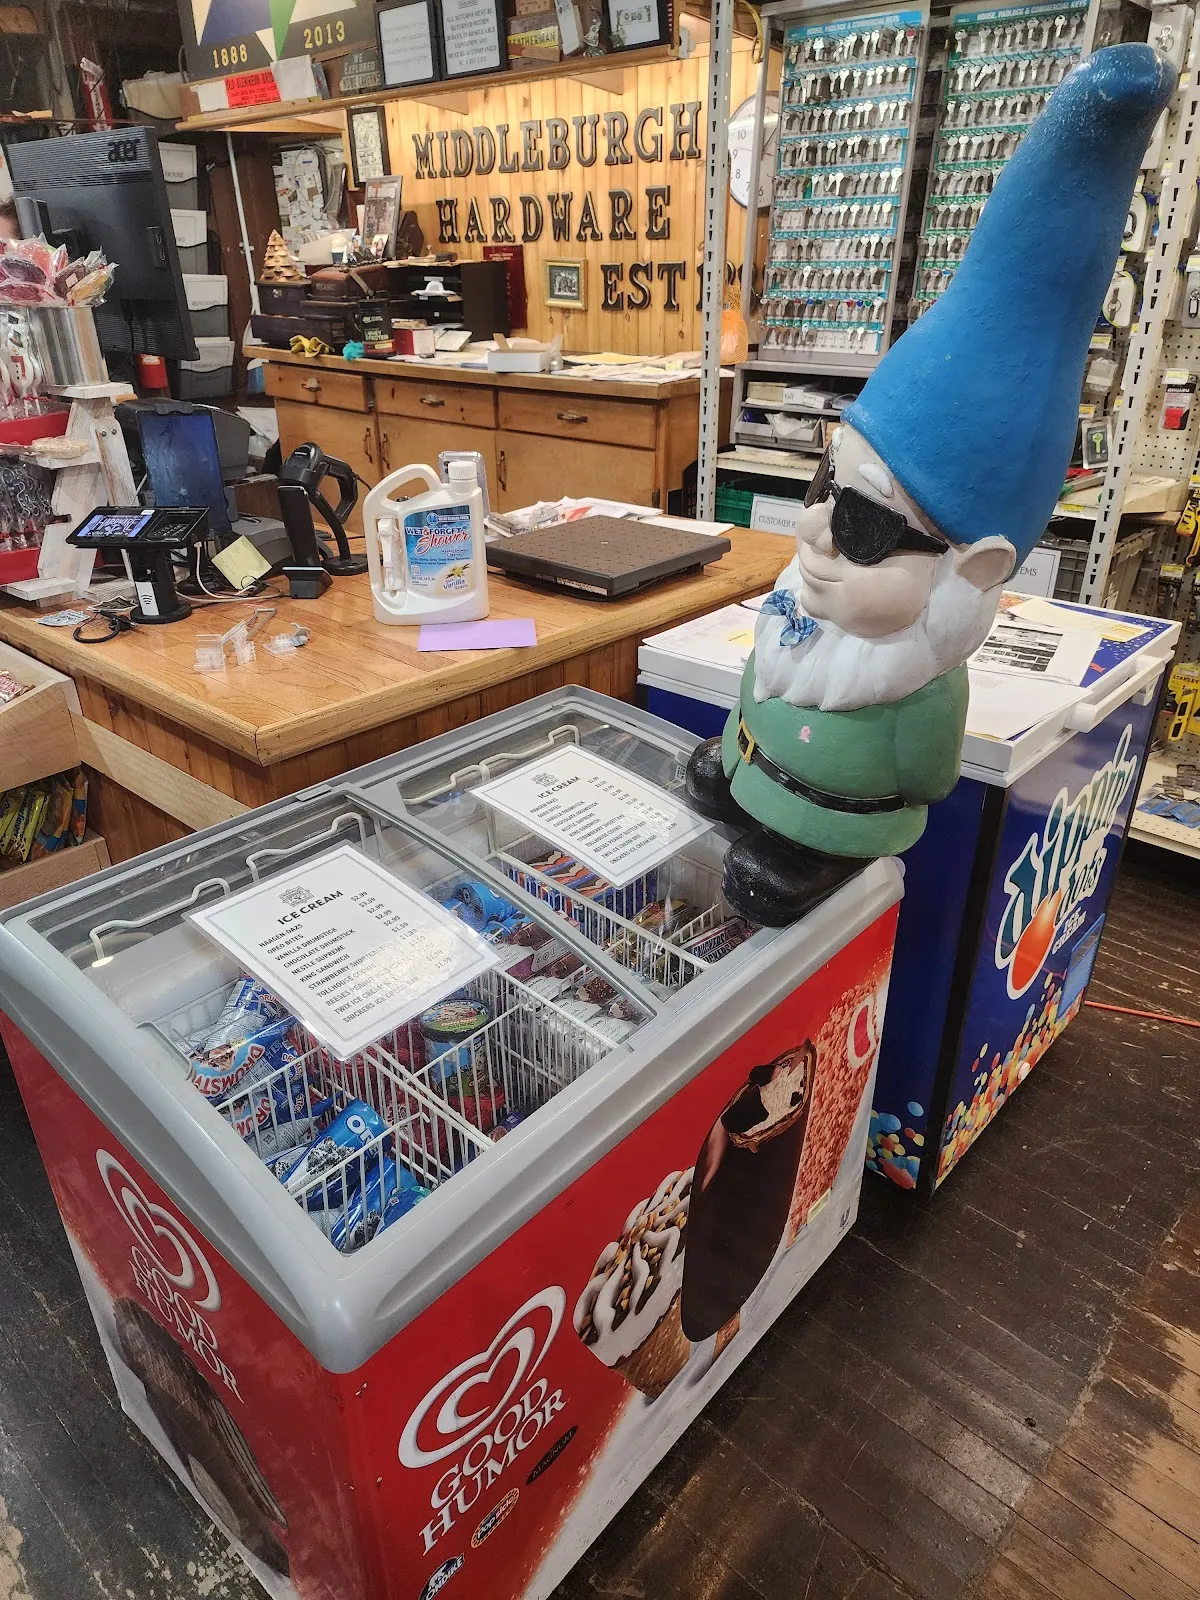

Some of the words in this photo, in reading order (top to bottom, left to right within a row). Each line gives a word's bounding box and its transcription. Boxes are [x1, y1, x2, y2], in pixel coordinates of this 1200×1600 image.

[1071, 0, 1087, 8] KEYS
[304, 20, 346, 49] 2013
[212, 43, 248, 69] 1888
[412, 101, 702, 180] MIDDLEBURGH
[737, 129, 747, 140] 10
[107, 139, 141, 163] acer
[732, 148, 739, 160] 9
[735, 168, 741, 179] 8
[758, 185, 764, 197] 6
[435, 185, 671, 244] HARDWARE
[601, 260, 686, 312] EST
[415, 531, 470, 556] Shower
[758, 515, 790, 528] CUSTOMER
[1019, 566, 1038, 577] EMS
[442, 579, 466, 590] Vanilla
[1172, 674, 1200, 685] STANLEY
[537, 790, 553, 799] ICE
[551, 776, 581, 792] CREAM
[277, 912, 300, 925] ICE
[299, 891, 344, 914] CREAM
[267, 944, 285, 954] OREO
[285, 934, 304, 945] BITES
[276, 946, 302, 961] VANILLA
[302, 928, 338, 947] DRUMSTICK
[368, 904, 384, 913] $2.99
[284, 947, 320, 968] CHOCOLATE
[319, 929, 355, 949] DRUMSTICK
[376, 910, 392, 920] $2.99
[292, 961, 317, 975] NESTLE
[316, 946, 345, 962] SUPREME
[300, 972, 317, 982] KING
[316, 954, 350, 973] SANDWICH
[308, 966, 351, 990] STRAWBERRY
[317, 976, 353, 998] TOLLHOUSE
[326, 991, 351, 1006] REESES
[335, 1003, 352, 1014] TWIX
[351, 997, 363, 1005] ICE
[344, 1003, 375, 1023] SNICKERS
[375, 996, 386, 1004] ICE
[430, 1377, 549, 1509] GOOD
[418, 1387, 567, 1557] HUMOR
